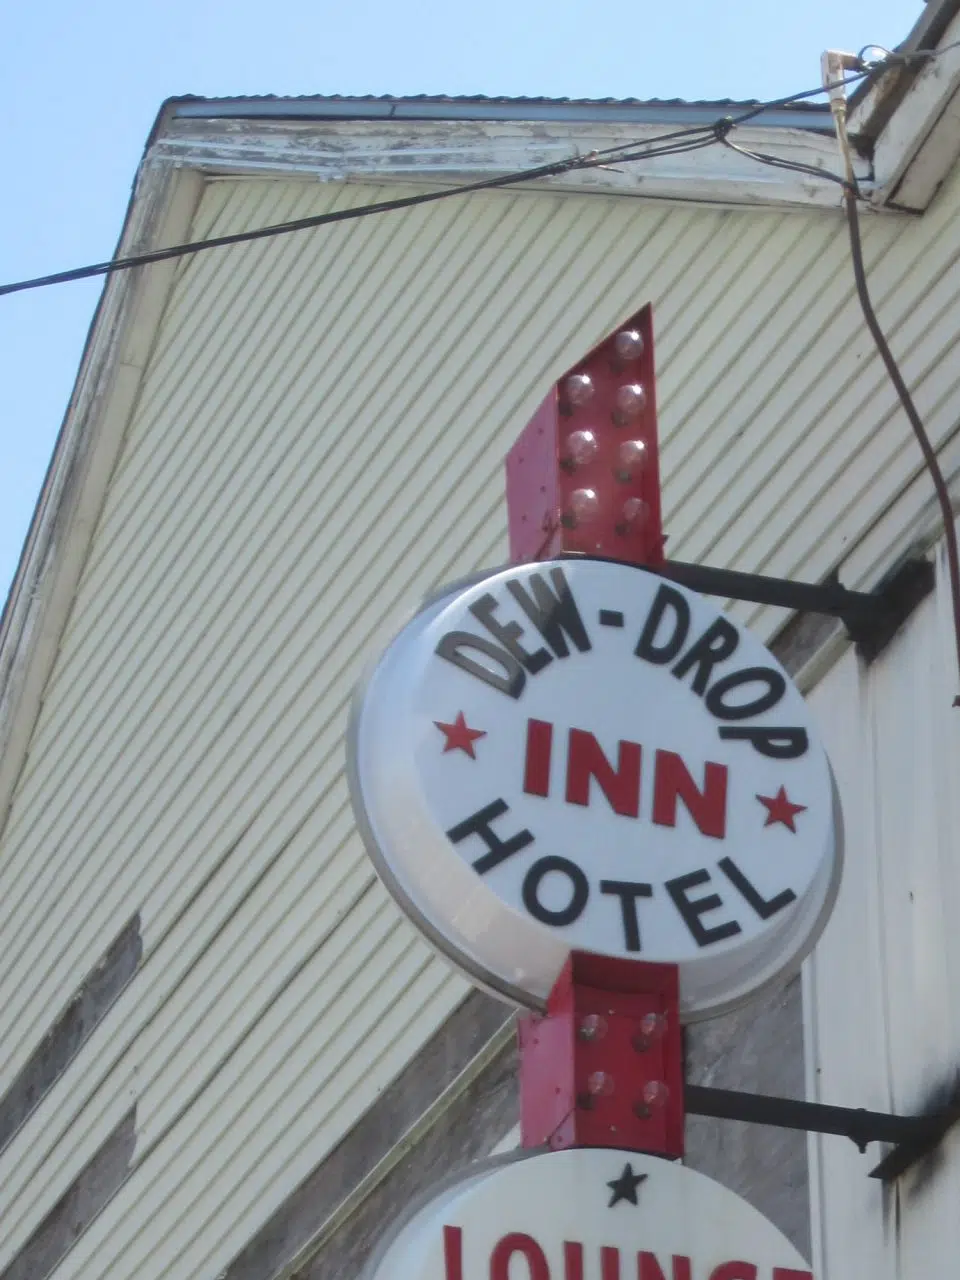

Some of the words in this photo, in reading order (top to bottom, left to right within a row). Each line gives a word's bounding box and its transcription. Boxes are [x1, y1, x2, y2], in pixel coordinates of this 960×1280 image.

[434, 566, 809, 760] DEW-DROP
[522, 717, 729, 840] INN
[446, 797, 798, 953] HOTEL
